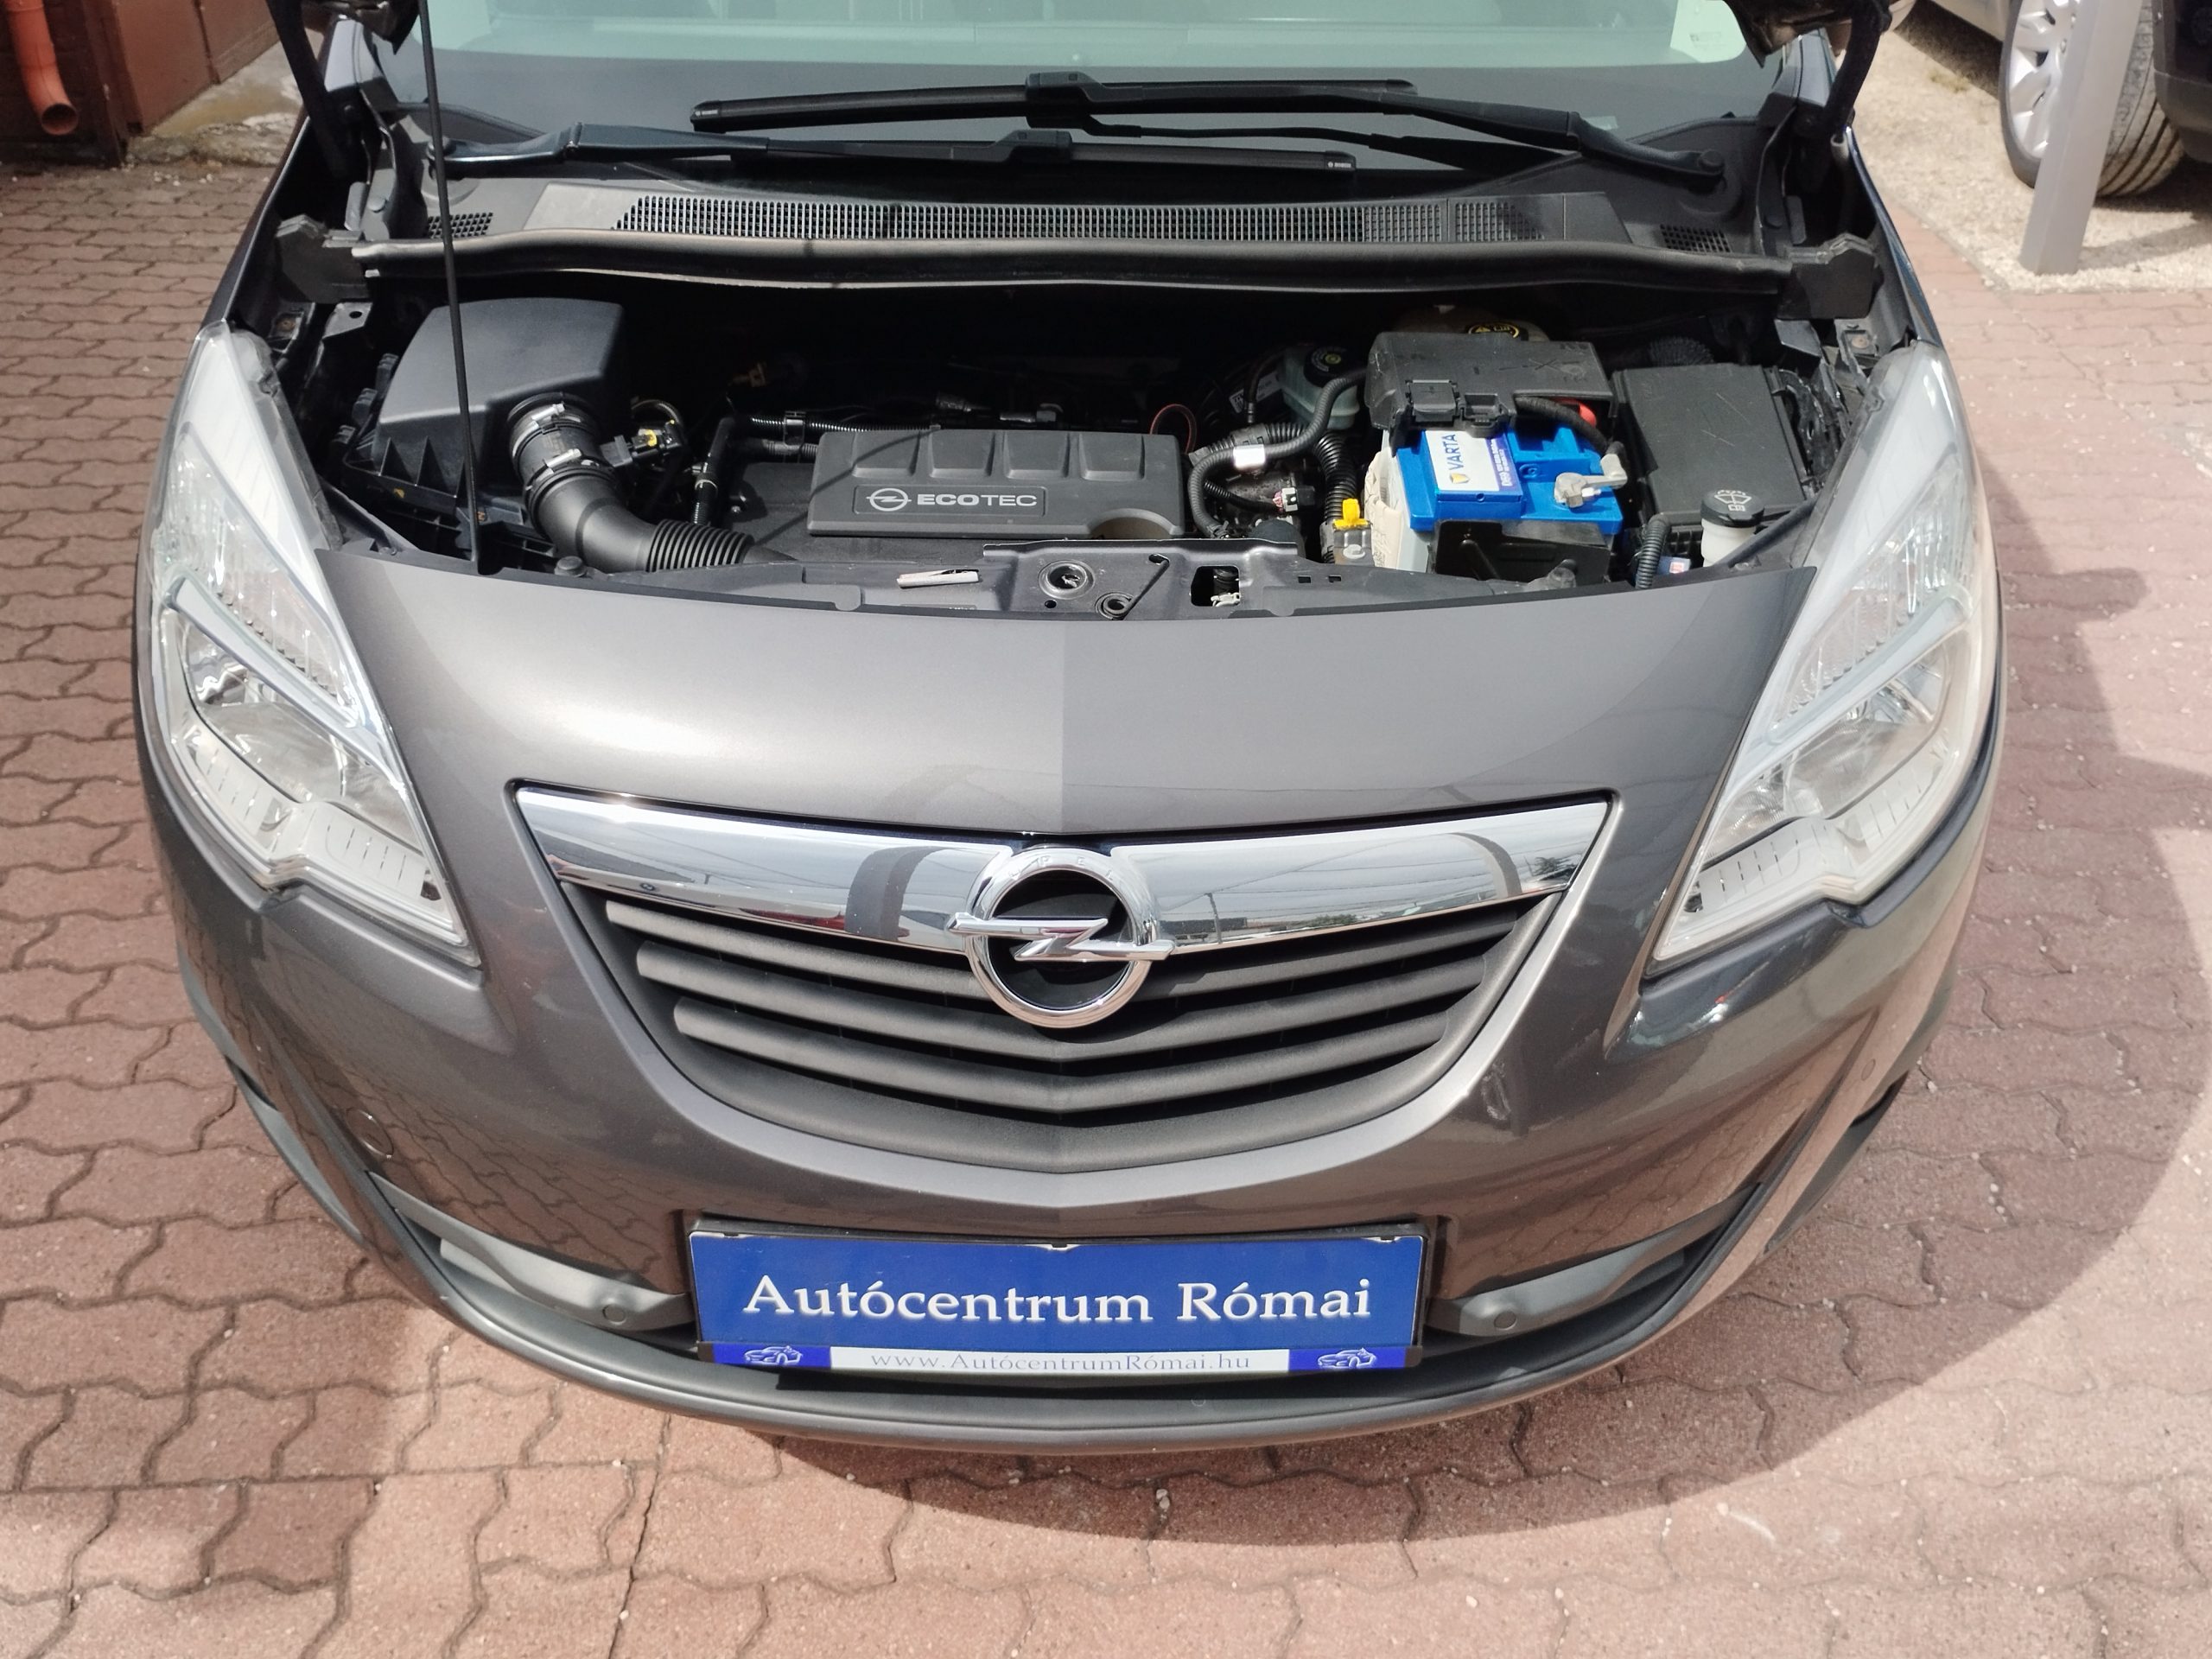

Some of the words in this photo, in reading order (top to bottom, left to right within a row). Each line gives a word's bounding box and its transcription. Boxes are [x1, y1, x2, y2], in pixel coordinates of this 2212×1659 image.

[1441, 434, 1464, 470] VARTA
[917, 493, 1038, 506] ECOTEC
[743, 1274, 1154, 1321] Autócentrum
[1176, 1278, 1370, 1320] Római
[871, 1354, 1250, 1370] www.AutócentrumRómai.hu
